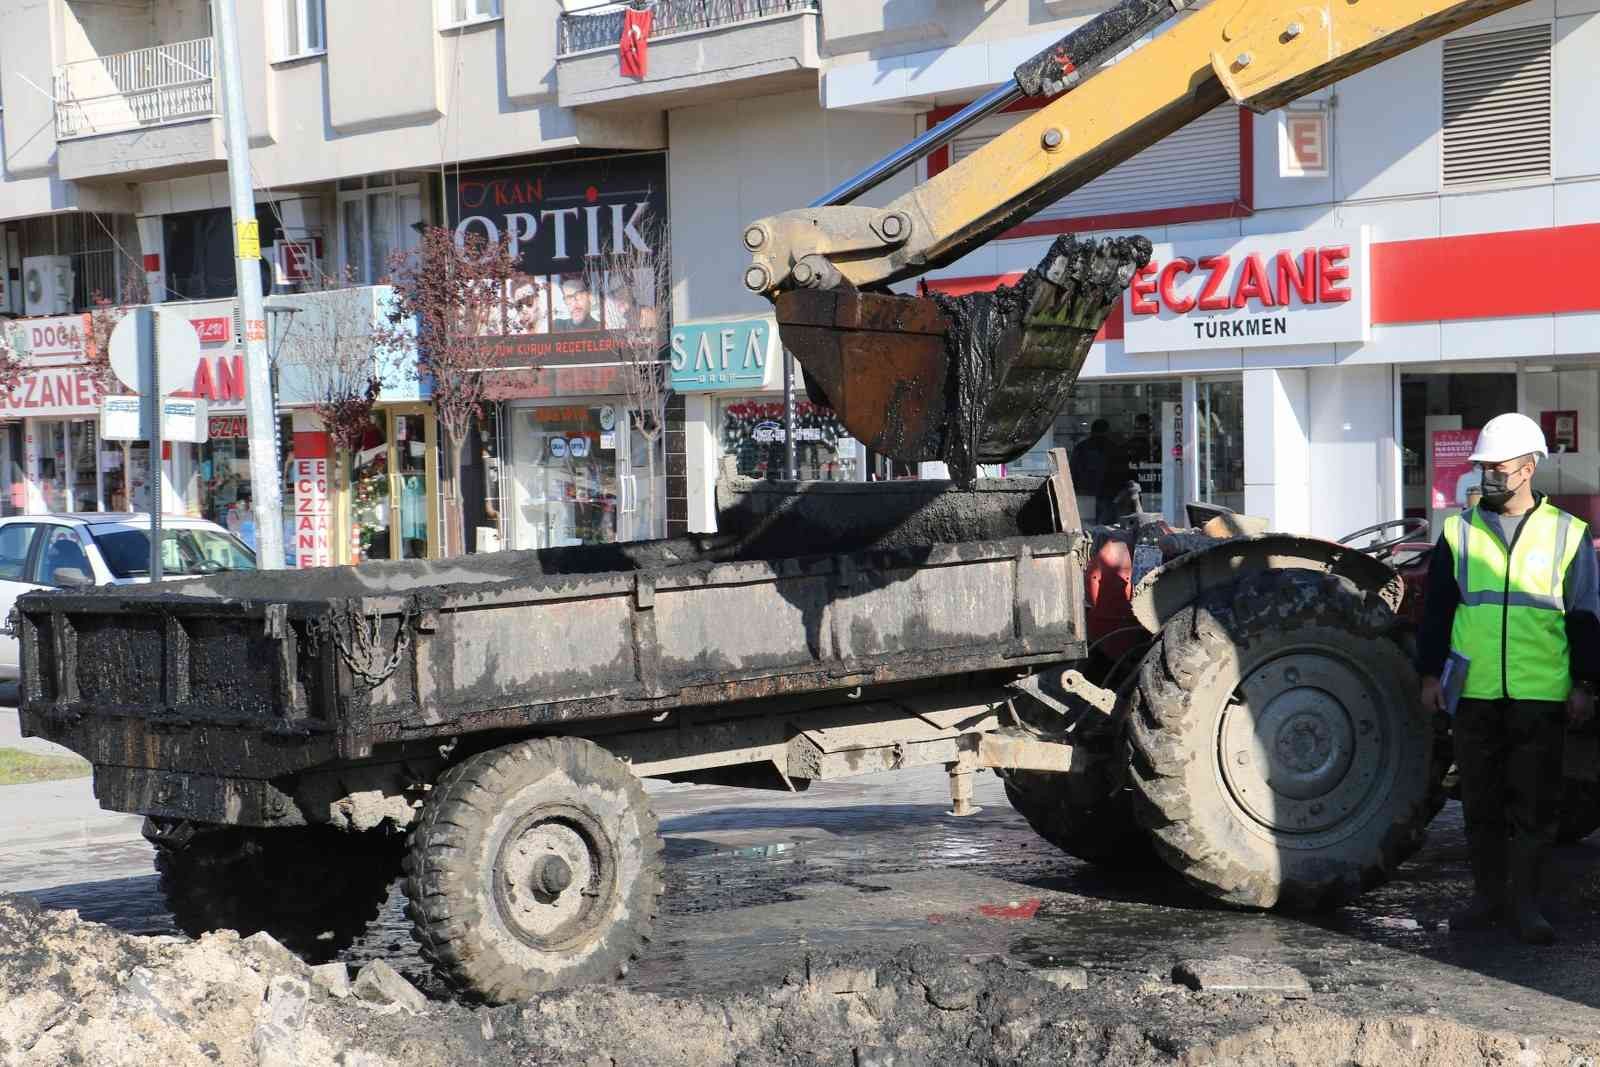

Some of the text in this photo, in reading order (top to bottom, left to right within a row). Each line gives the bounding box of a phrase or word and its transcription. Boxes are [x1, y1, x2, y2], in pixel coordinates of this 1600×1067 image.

[1293, 122, 1318, 162] E
[1130, 246, 1352, 315] ECZANE
[1194, 316, 1287, 339] TÜRKMEN
[671, 328, 764, 371] SAFA
[298, 461, 314, 568] ECZANE
